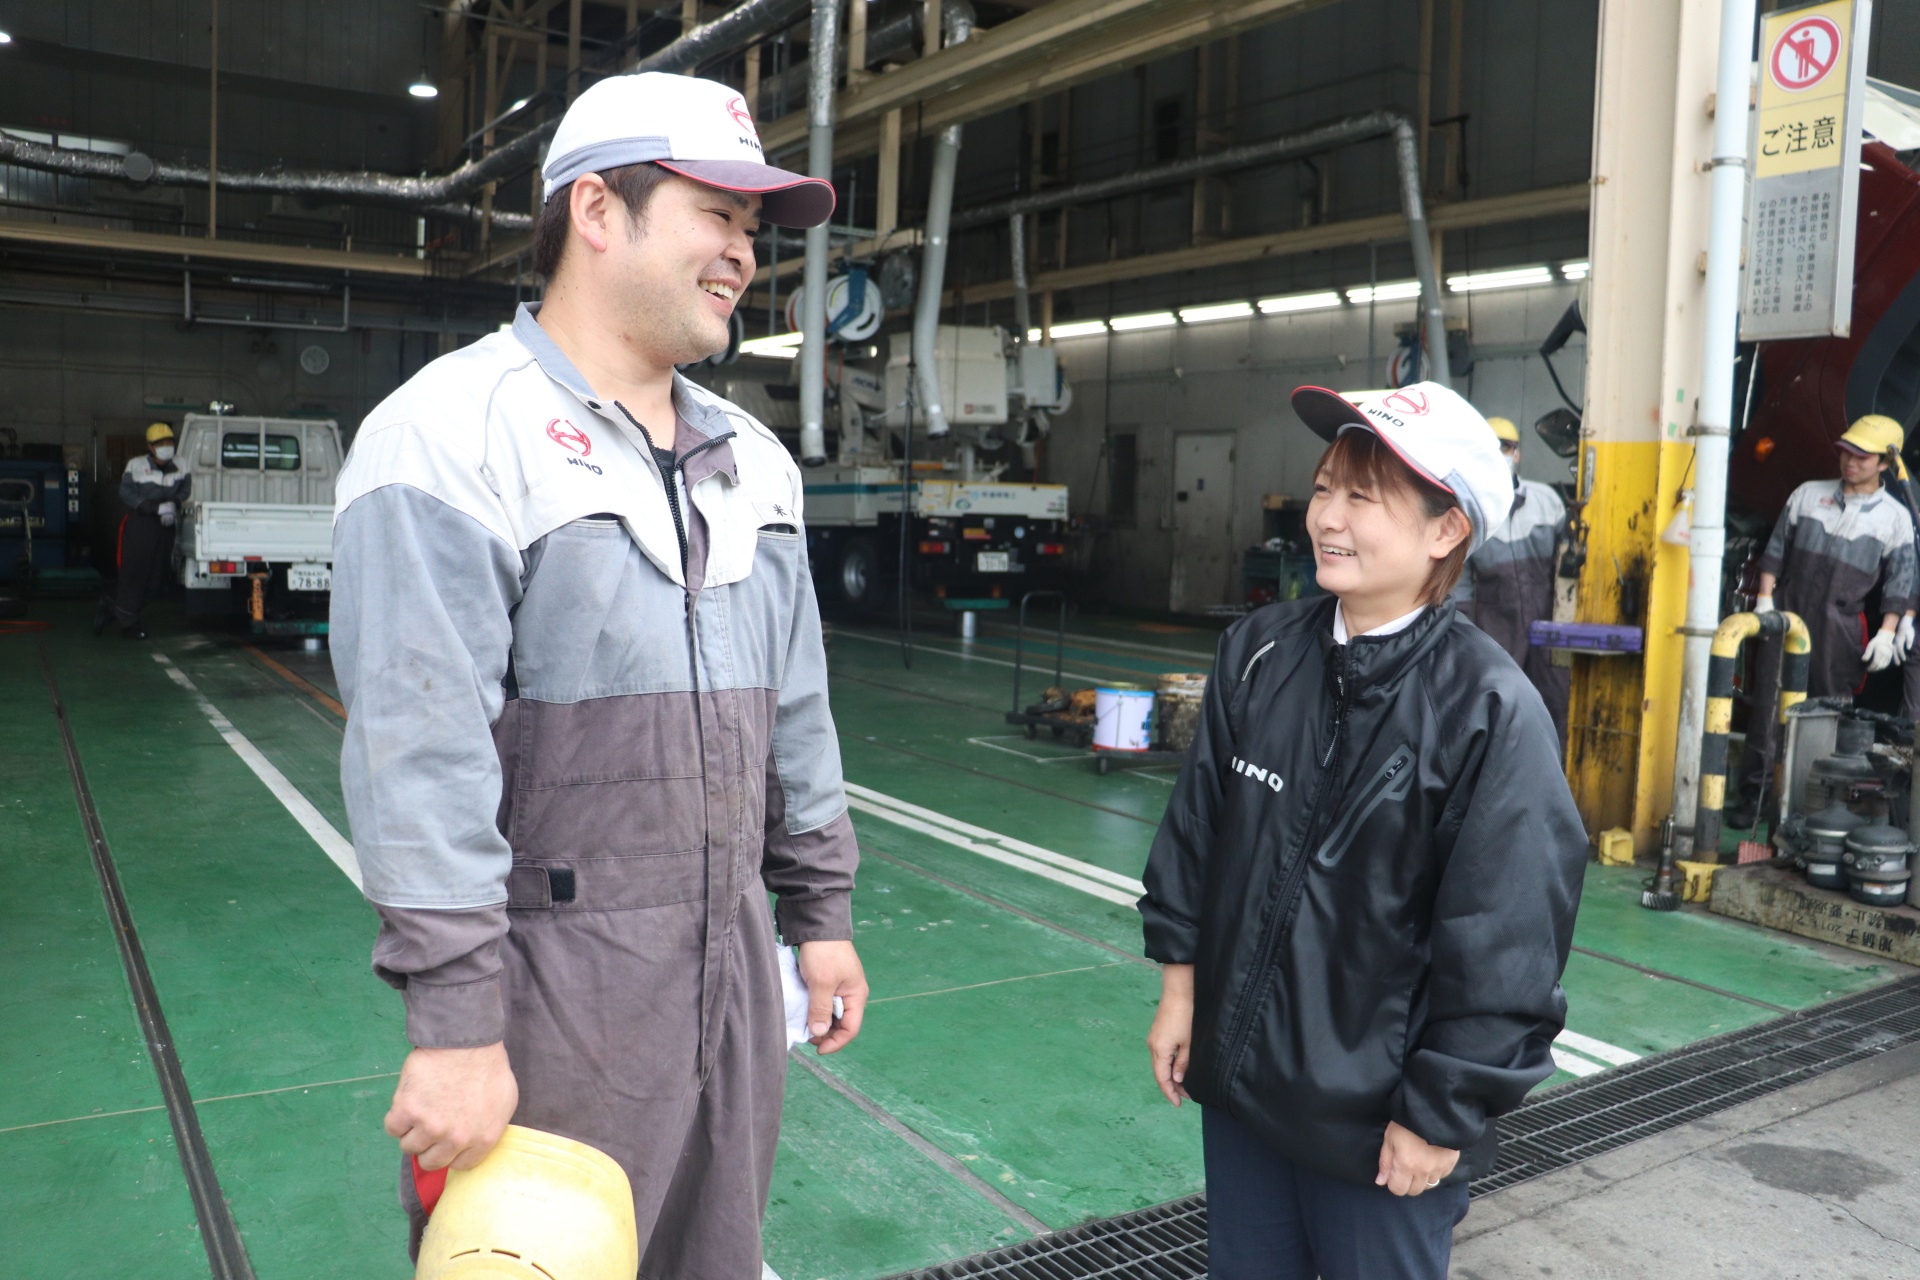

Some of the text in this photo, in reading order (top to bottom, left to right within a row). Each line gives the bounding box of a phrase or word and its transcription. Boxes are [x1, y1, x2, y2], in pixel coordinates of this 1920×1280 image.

[1763, 116, 1835, 155] ご注意
[1368, 408, 1405, 427] HINO
[566, 457, 603, 475] HINO
